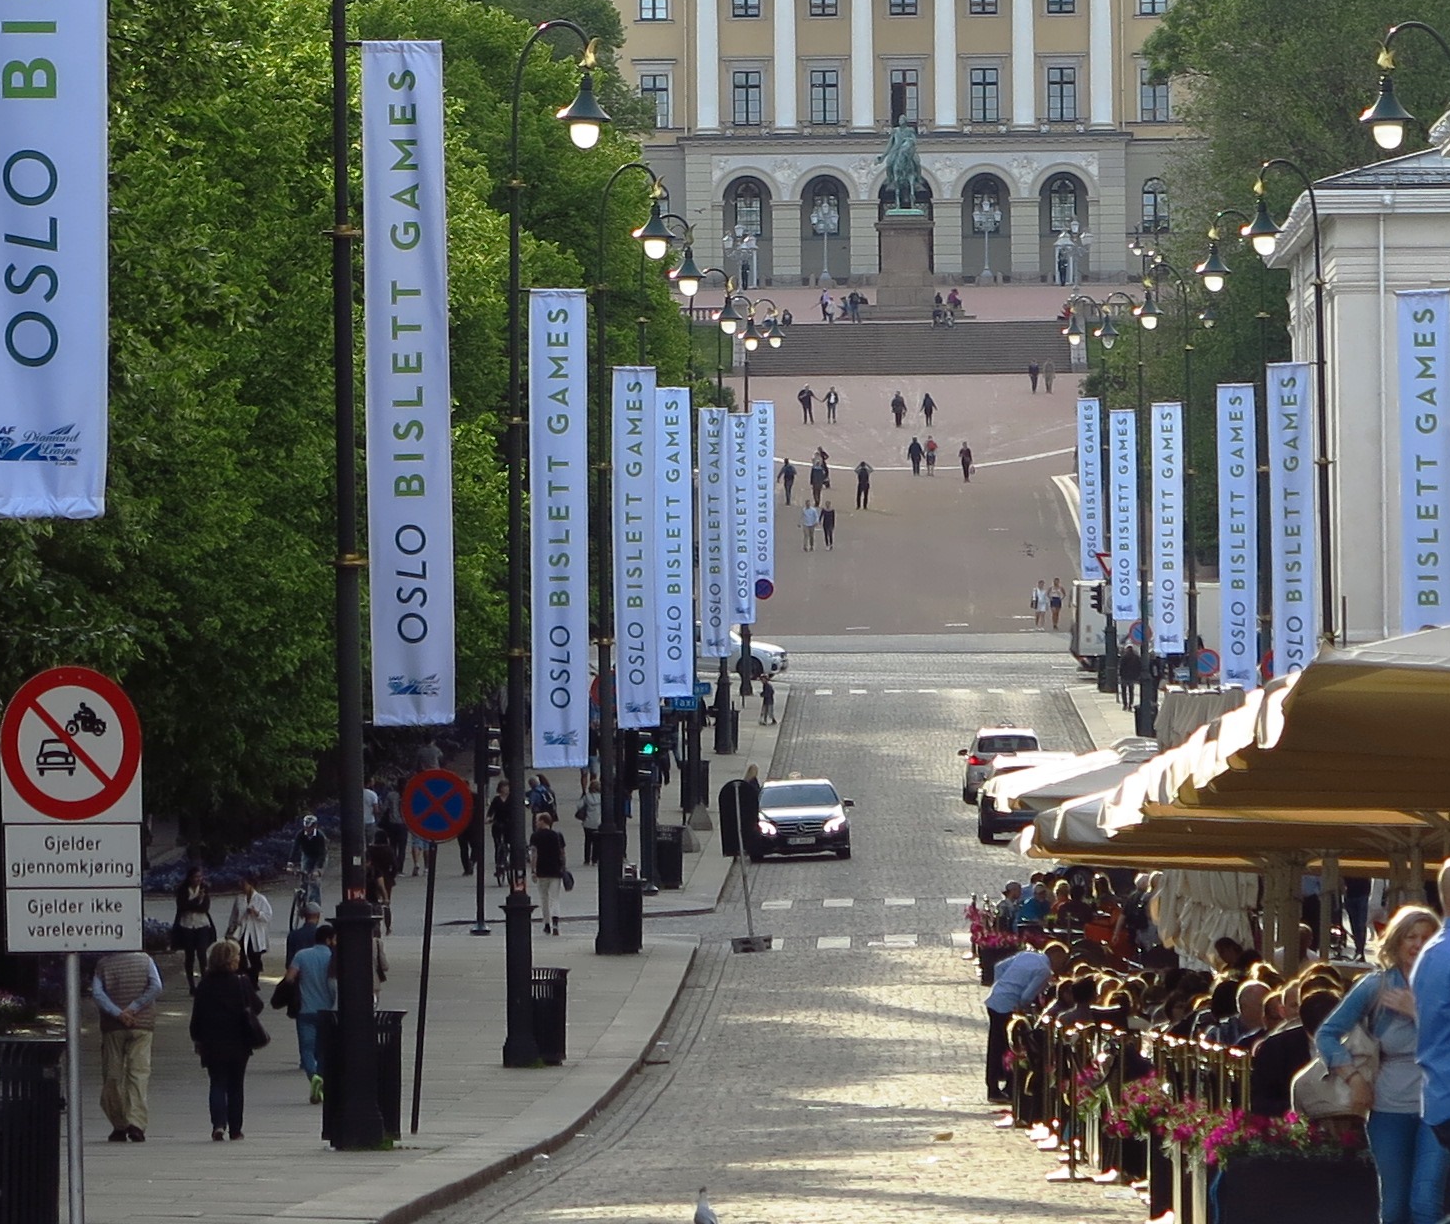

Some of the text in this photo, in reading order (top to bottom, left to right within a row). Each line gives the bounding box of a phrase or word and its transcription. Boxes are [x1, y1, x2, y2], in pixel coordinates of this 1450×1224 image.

[388, 67, 420, 251] GAMES
[3, 149, 58, 367] OSLO
[392, 280, 425, 497] BISLETT
[547, 307, 569, 435] GAMES
[1281, 376, 1299, 472] GAMES
[1413, 307, 1437, 436] GAMES
[548, 456, 570, 608] BISLETT
[625, 380, 644, 686] OSLO BISLETT GAMES
[665, 399, 682, 661] OSLO BISLETT GAMES
[707, 417, 722, 628] OSLO BISLETT GAMES
[735, 420, 748, 598] OSLO BISLETT GAMES
[757, 407, 768, 562] OSLO BISLETT GAMES
[1083, 404, 1097, 559] OSLO BISLETT GAMES
[1117, 417, 1131, 597] OSLO BISLETT GAMES
[1161, 411, 1175, 624] OSLO BISLETT GAMES
[1228, 394, 1246, 656] OSLO BISLETT GAMES
[1283, 487, 1304, 604] BISLETT
[1415, 454, 1440, 607] BISLETT
[395, 523, 428, 644] OSLO
[551, 624, 571, 709] OSLO
[11, 856, 134, 879] gjennomkjøring
[27, 897, 123, 918] Gjelder ikke
[44, 834, 102, 855] Gjelder
[27, 920, 124, 940] varelevering
